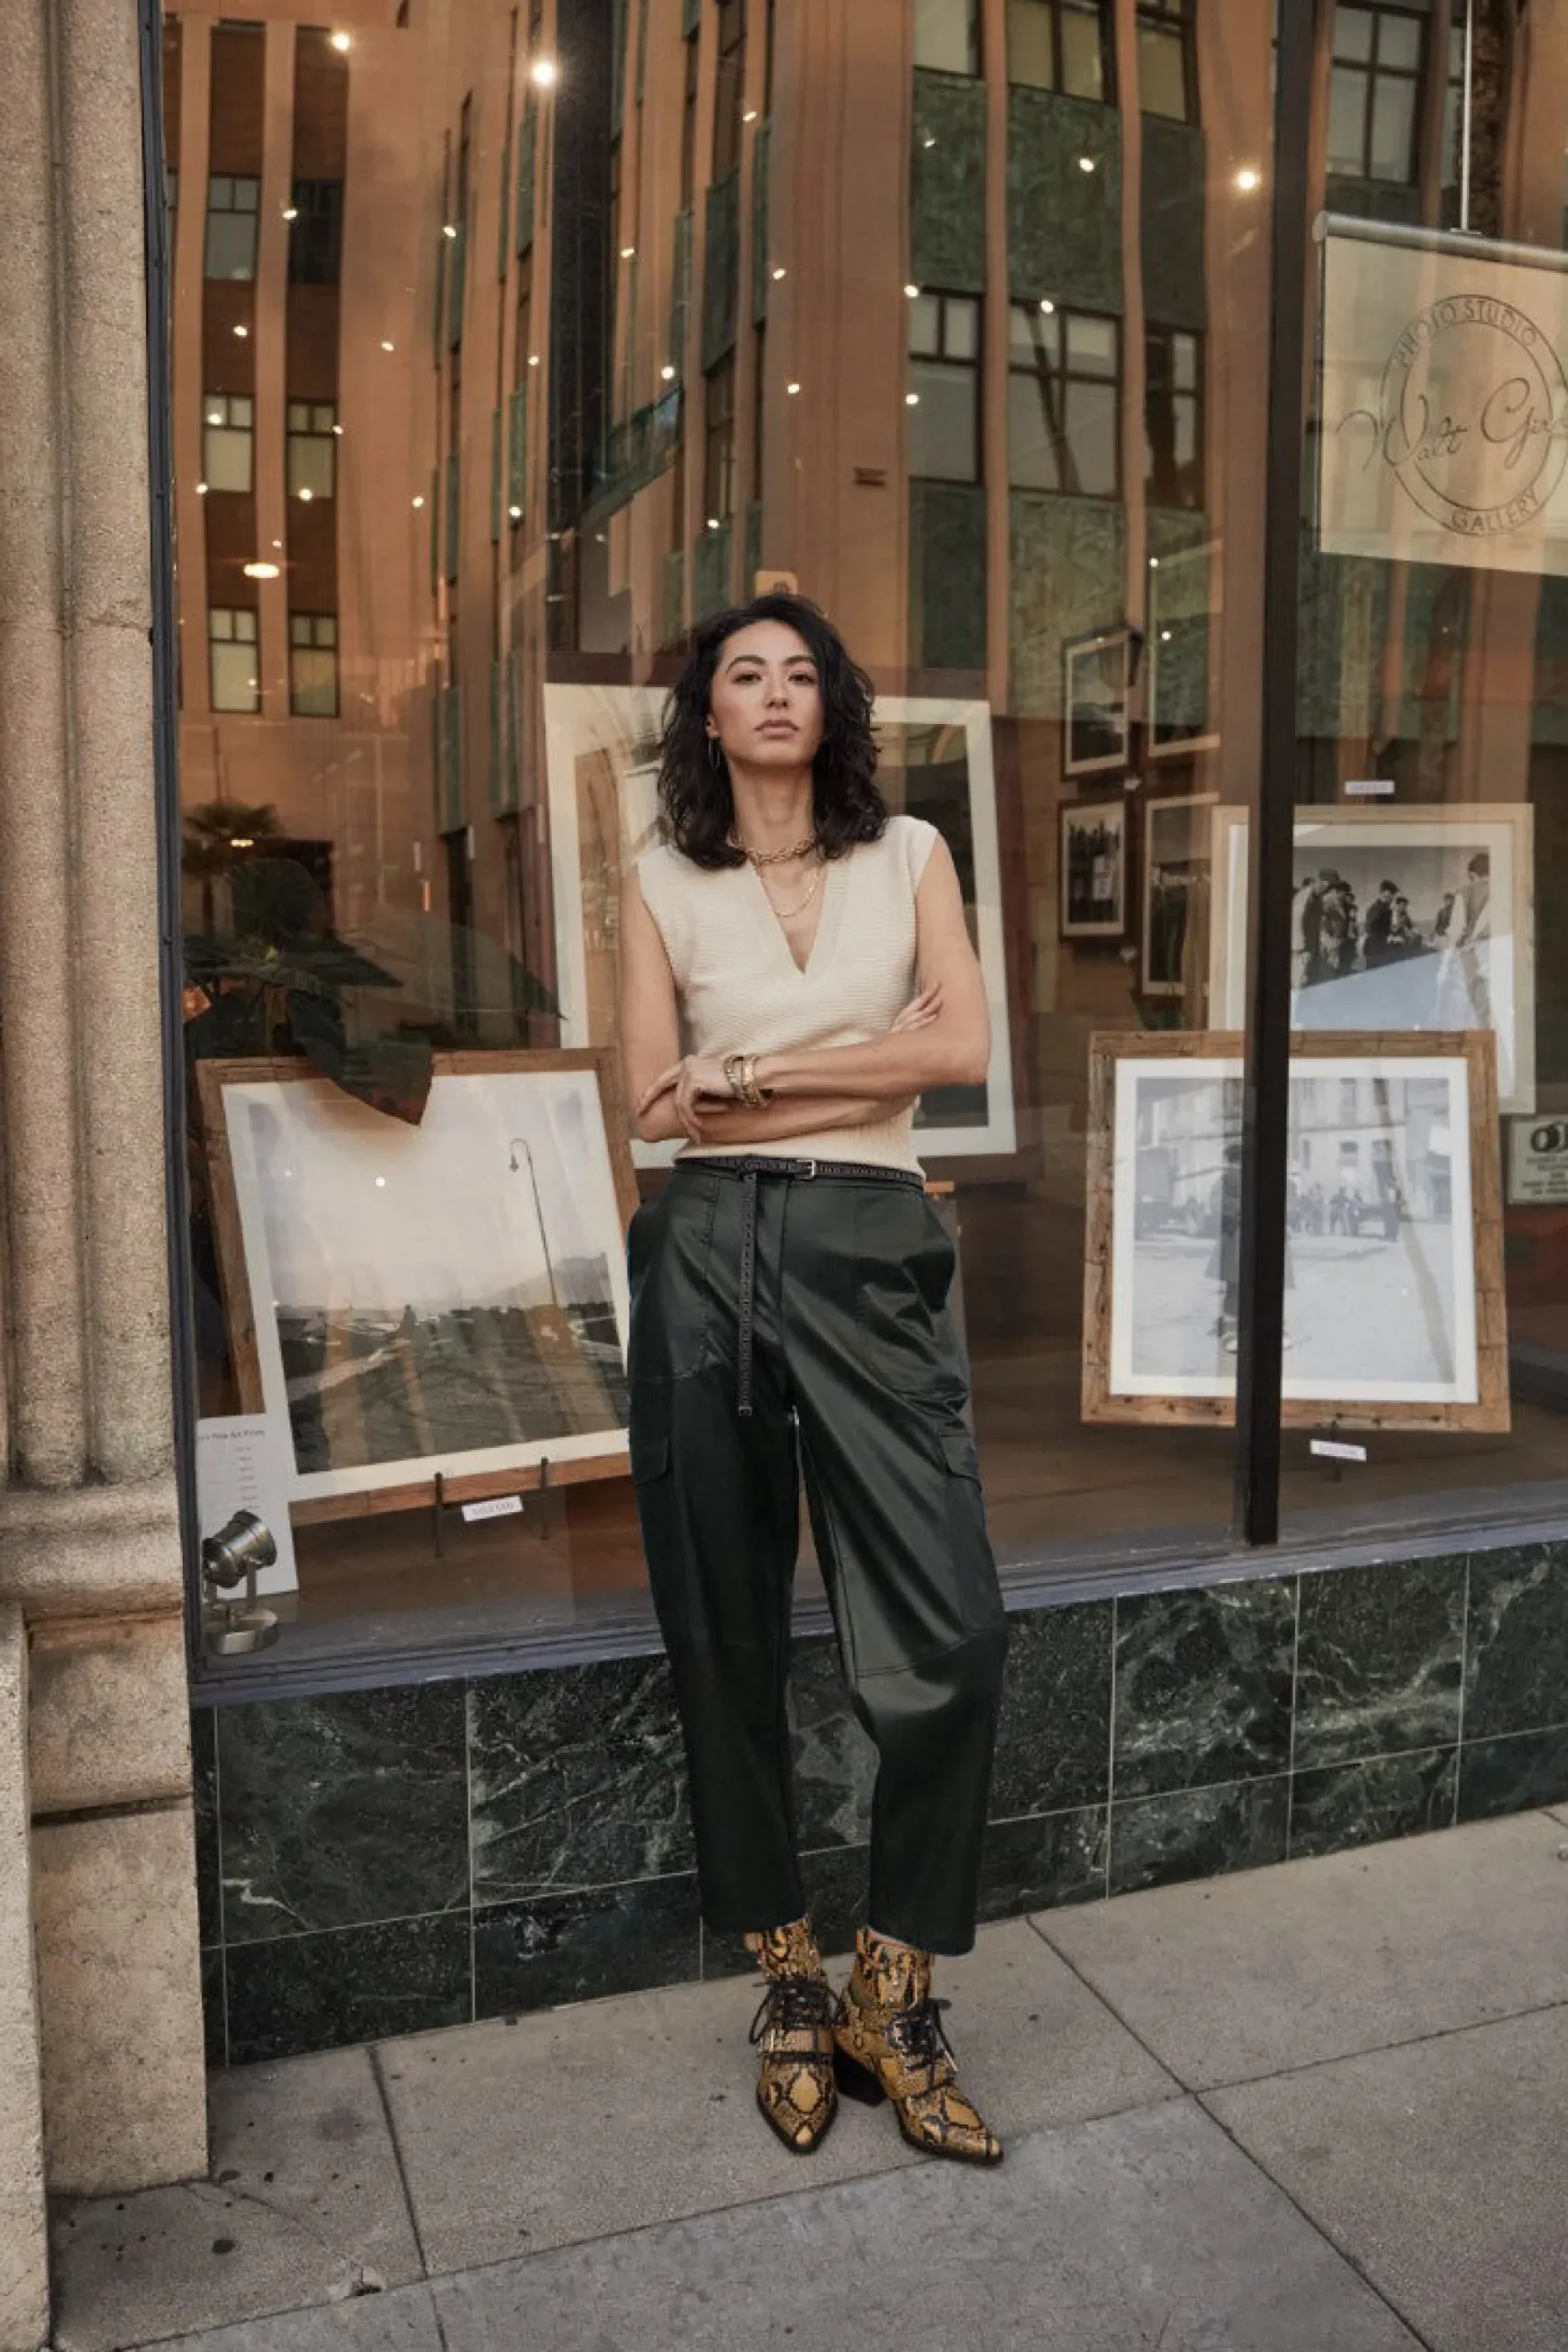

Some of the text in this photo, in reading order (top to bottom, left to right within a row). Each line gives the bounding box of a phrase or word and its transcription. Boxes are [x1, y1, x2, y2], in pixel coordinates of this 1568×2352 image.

[1395, 299, 1537, 368] PHOTO STUDIO
[1451, 487, 1539, 533] GALLERY
